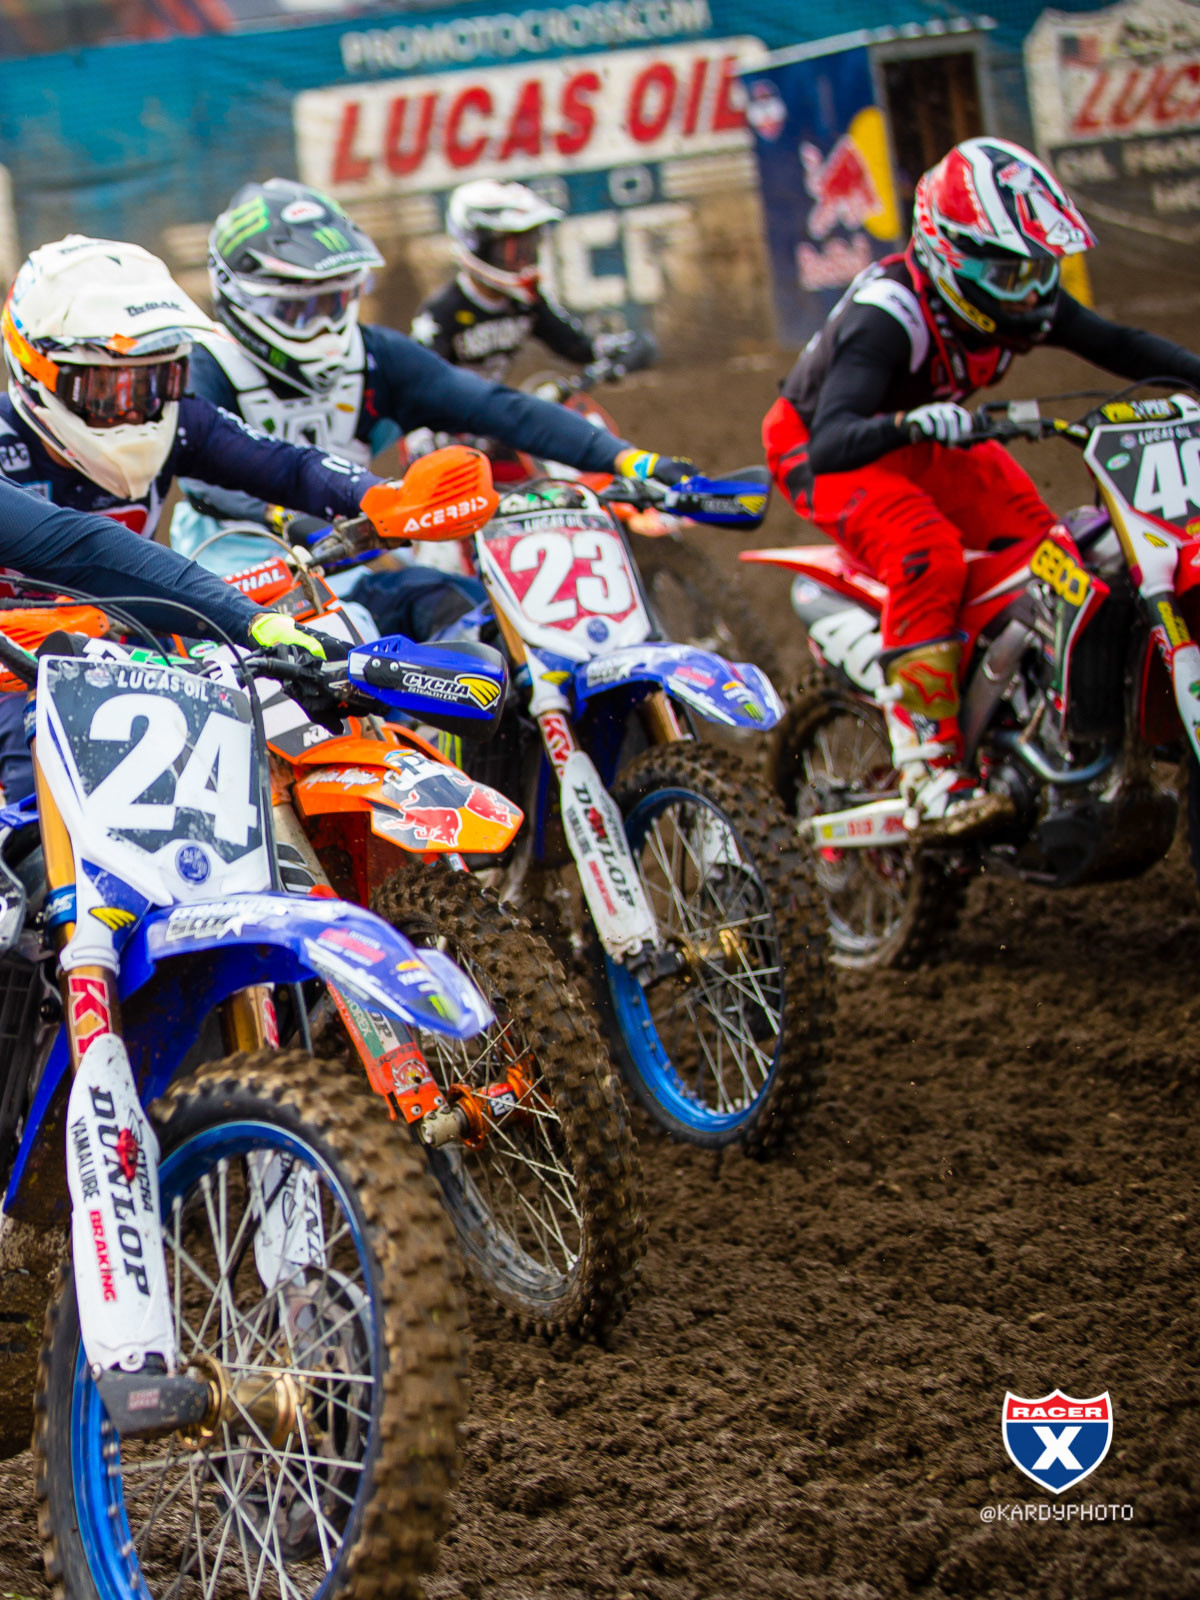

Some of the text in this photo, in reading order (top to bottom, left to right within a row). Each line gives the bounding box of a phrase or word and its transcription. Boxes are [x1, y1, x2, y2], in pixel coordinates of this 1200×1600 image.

[330, 53, 748, 183] LUCAS OIL
[402, 495, 490, 534] ACERBIS
[509, 531, 633, 624] 23
[116, 669, 210, 702] LUCAS OIL
[403, 672, 472, 698] CYCRA
[82, 693, 258, 847] 24
[70, 1115, 102, 1204] YAMALUBE
[88, 1085, 151, 1297] DUNLOP
[88, 1209, 118, 1303] BRAKING
